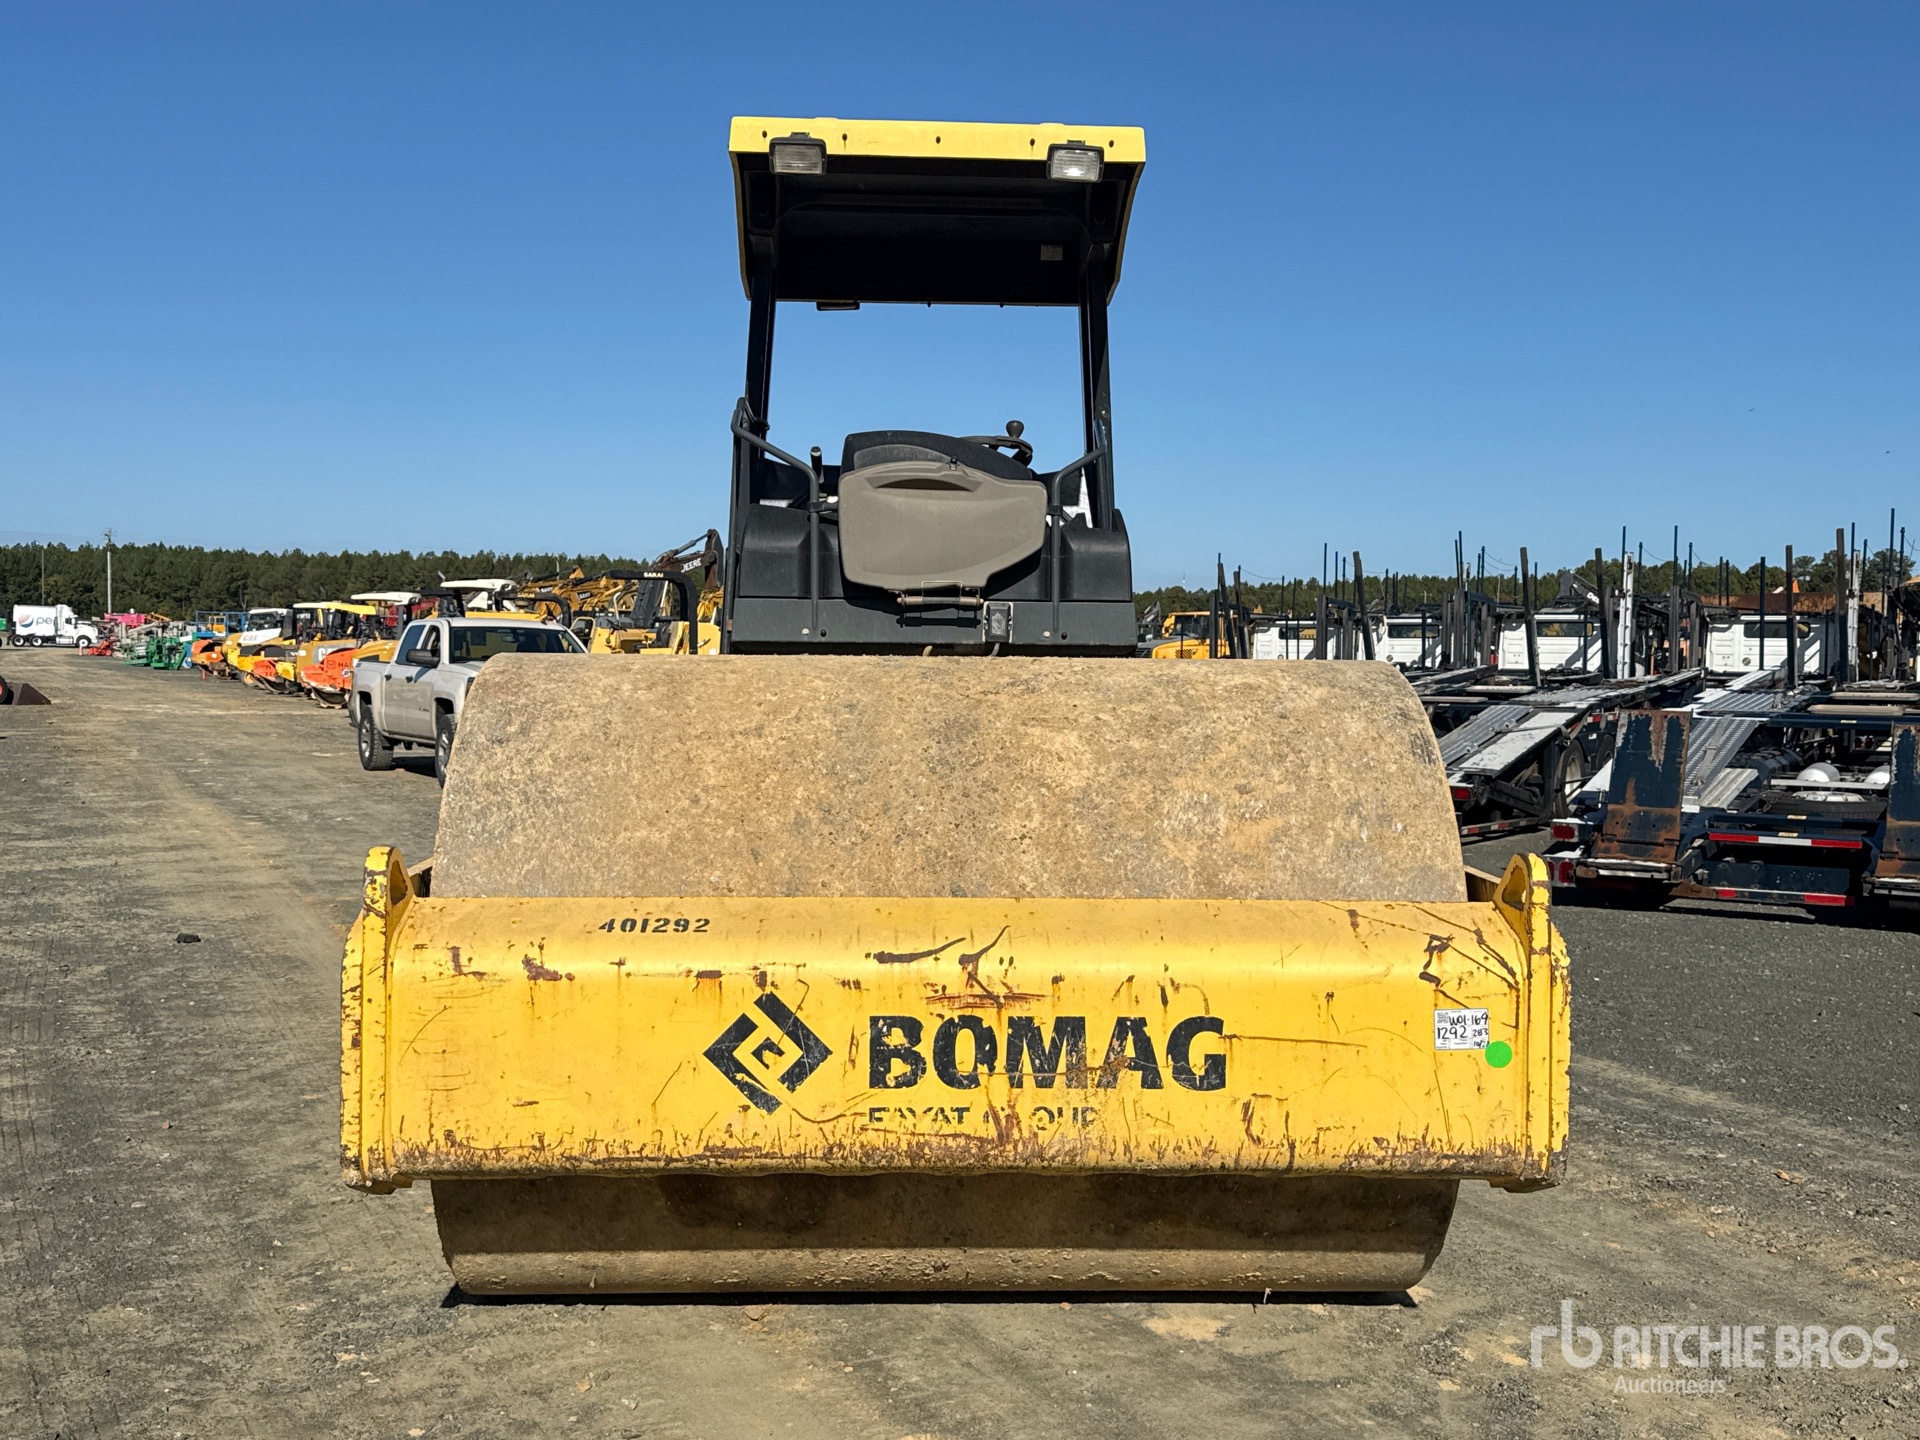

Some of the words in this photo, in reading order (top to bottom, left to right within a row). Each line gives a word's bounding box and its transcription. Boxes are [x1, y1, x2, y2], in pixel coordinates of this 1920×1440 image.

[598, 918, 711, 933] 401292
[1437, 1025, 1468, 1040] 1292
[869, 1015, 1226, 1091] BOMAG
